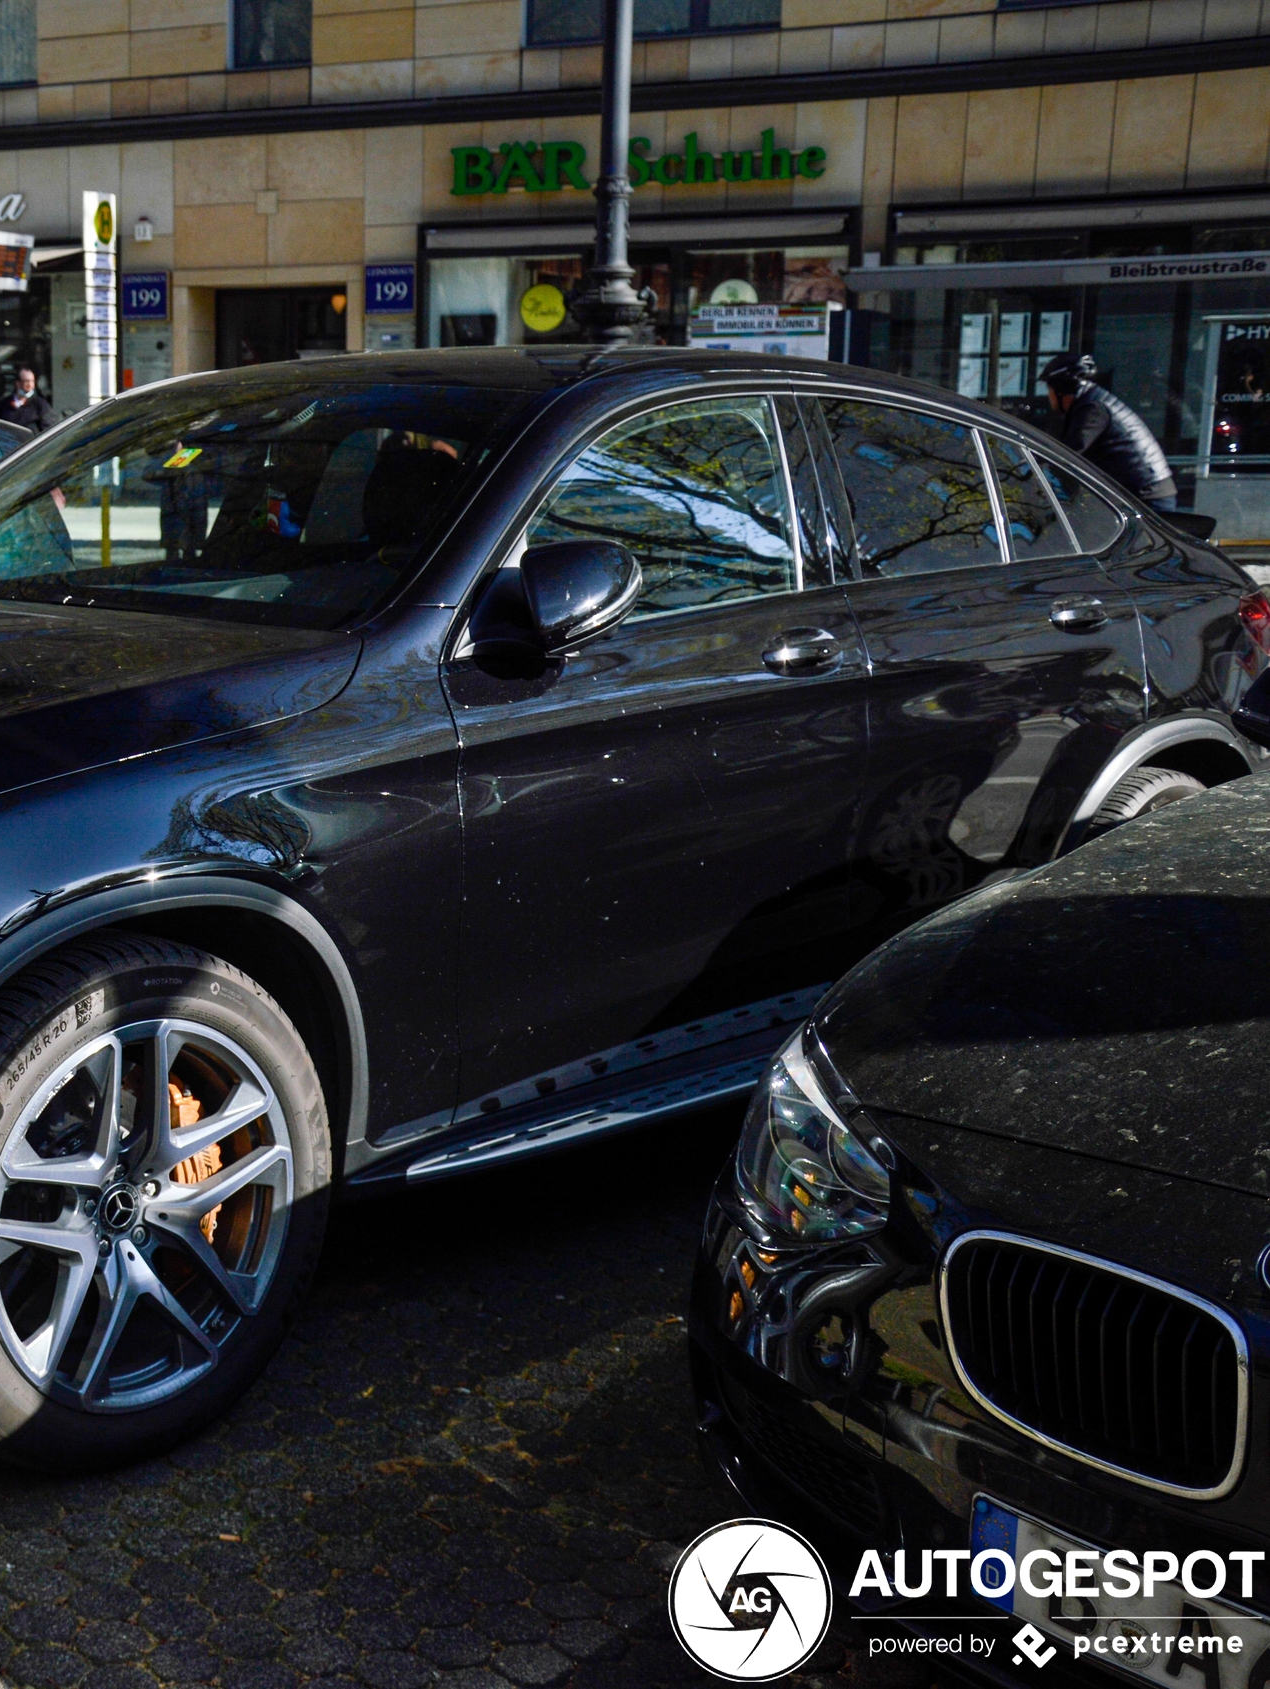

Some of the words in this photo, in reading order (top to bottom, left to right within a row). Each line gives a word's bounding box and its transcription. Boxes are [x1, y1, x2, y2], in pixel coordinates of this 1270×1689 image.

[450, 140, 591, 197] BÄR
[629, 127, 827, 187] Schuhe
[1109, 258, 1267, 279] Bleibtreustraße
[131, 288, 161, 308] 199
[376, 281, 408, 302] 199
[701, 306, 735, 318] BERLIN
[716, 319, 773, 331] IMMOBILIEN
[151, 978, 183, 986] ROTATION
[6, 1045, 42, 1091] 265/45
[42, 1034, 53, 1049] R
[52, 1020, 68, 1040] 20
